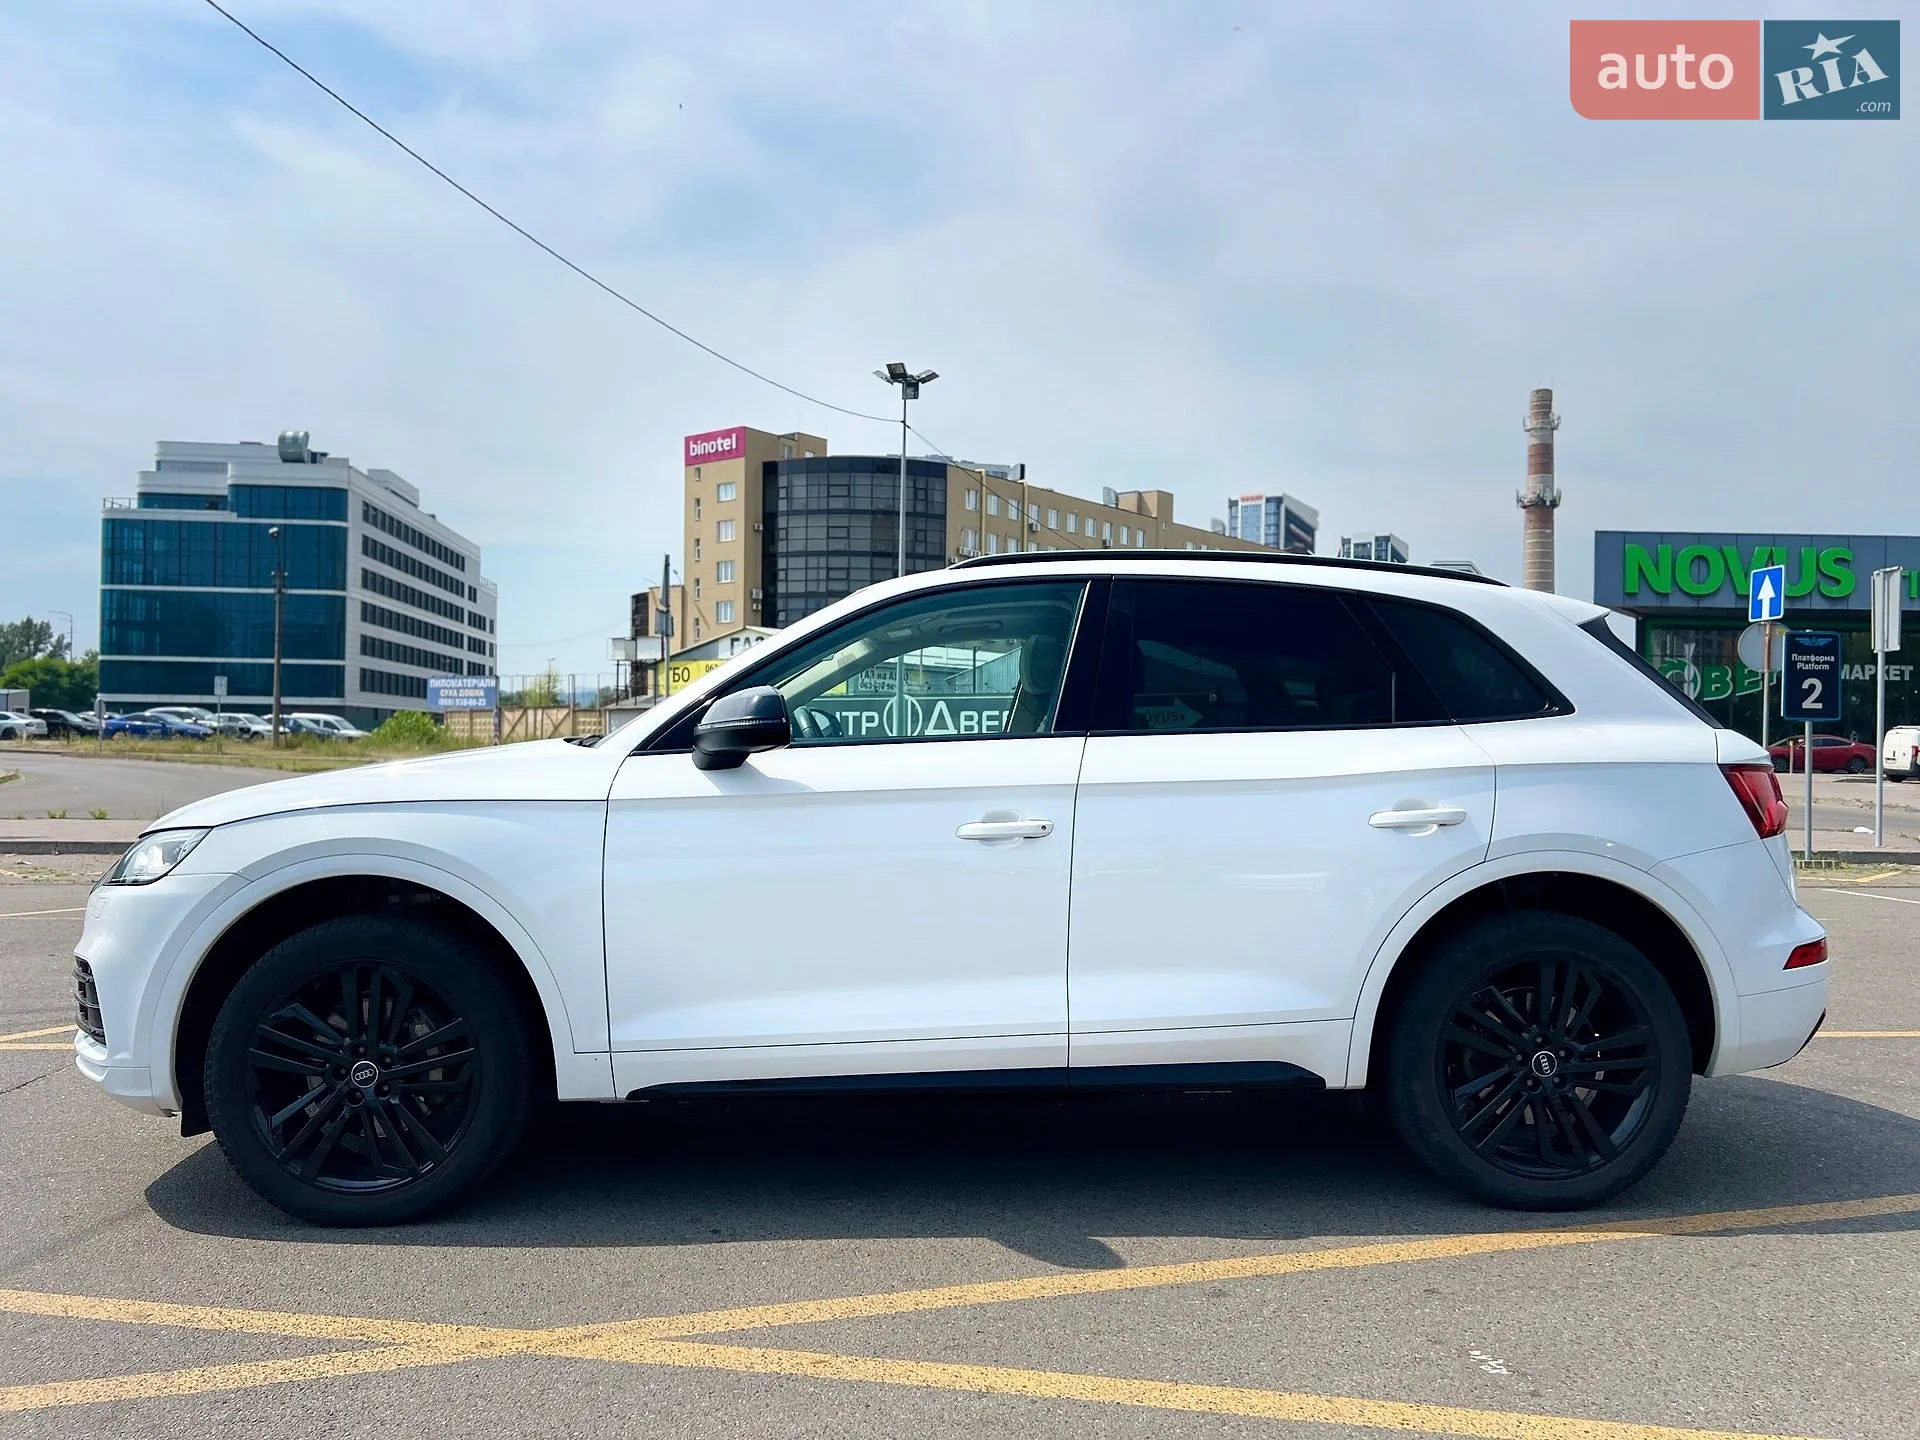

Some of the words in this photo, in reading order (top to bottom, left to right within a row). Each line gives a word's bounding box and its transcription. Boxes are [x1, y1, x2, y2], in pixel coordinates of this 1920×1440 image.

[689, 433, 737, 457] binotel
[1624, 543, 1857, 598] NOVUS
[730, 636, 765, 656] ГА
[1791, 653, 1835, 663] Платформа
[1796, 662, 1830, 671] Platform
[669, 667, 691, 683] БО
[1801, 678, 1823, 709] 2
[836, 712, 879, 735] ТР
